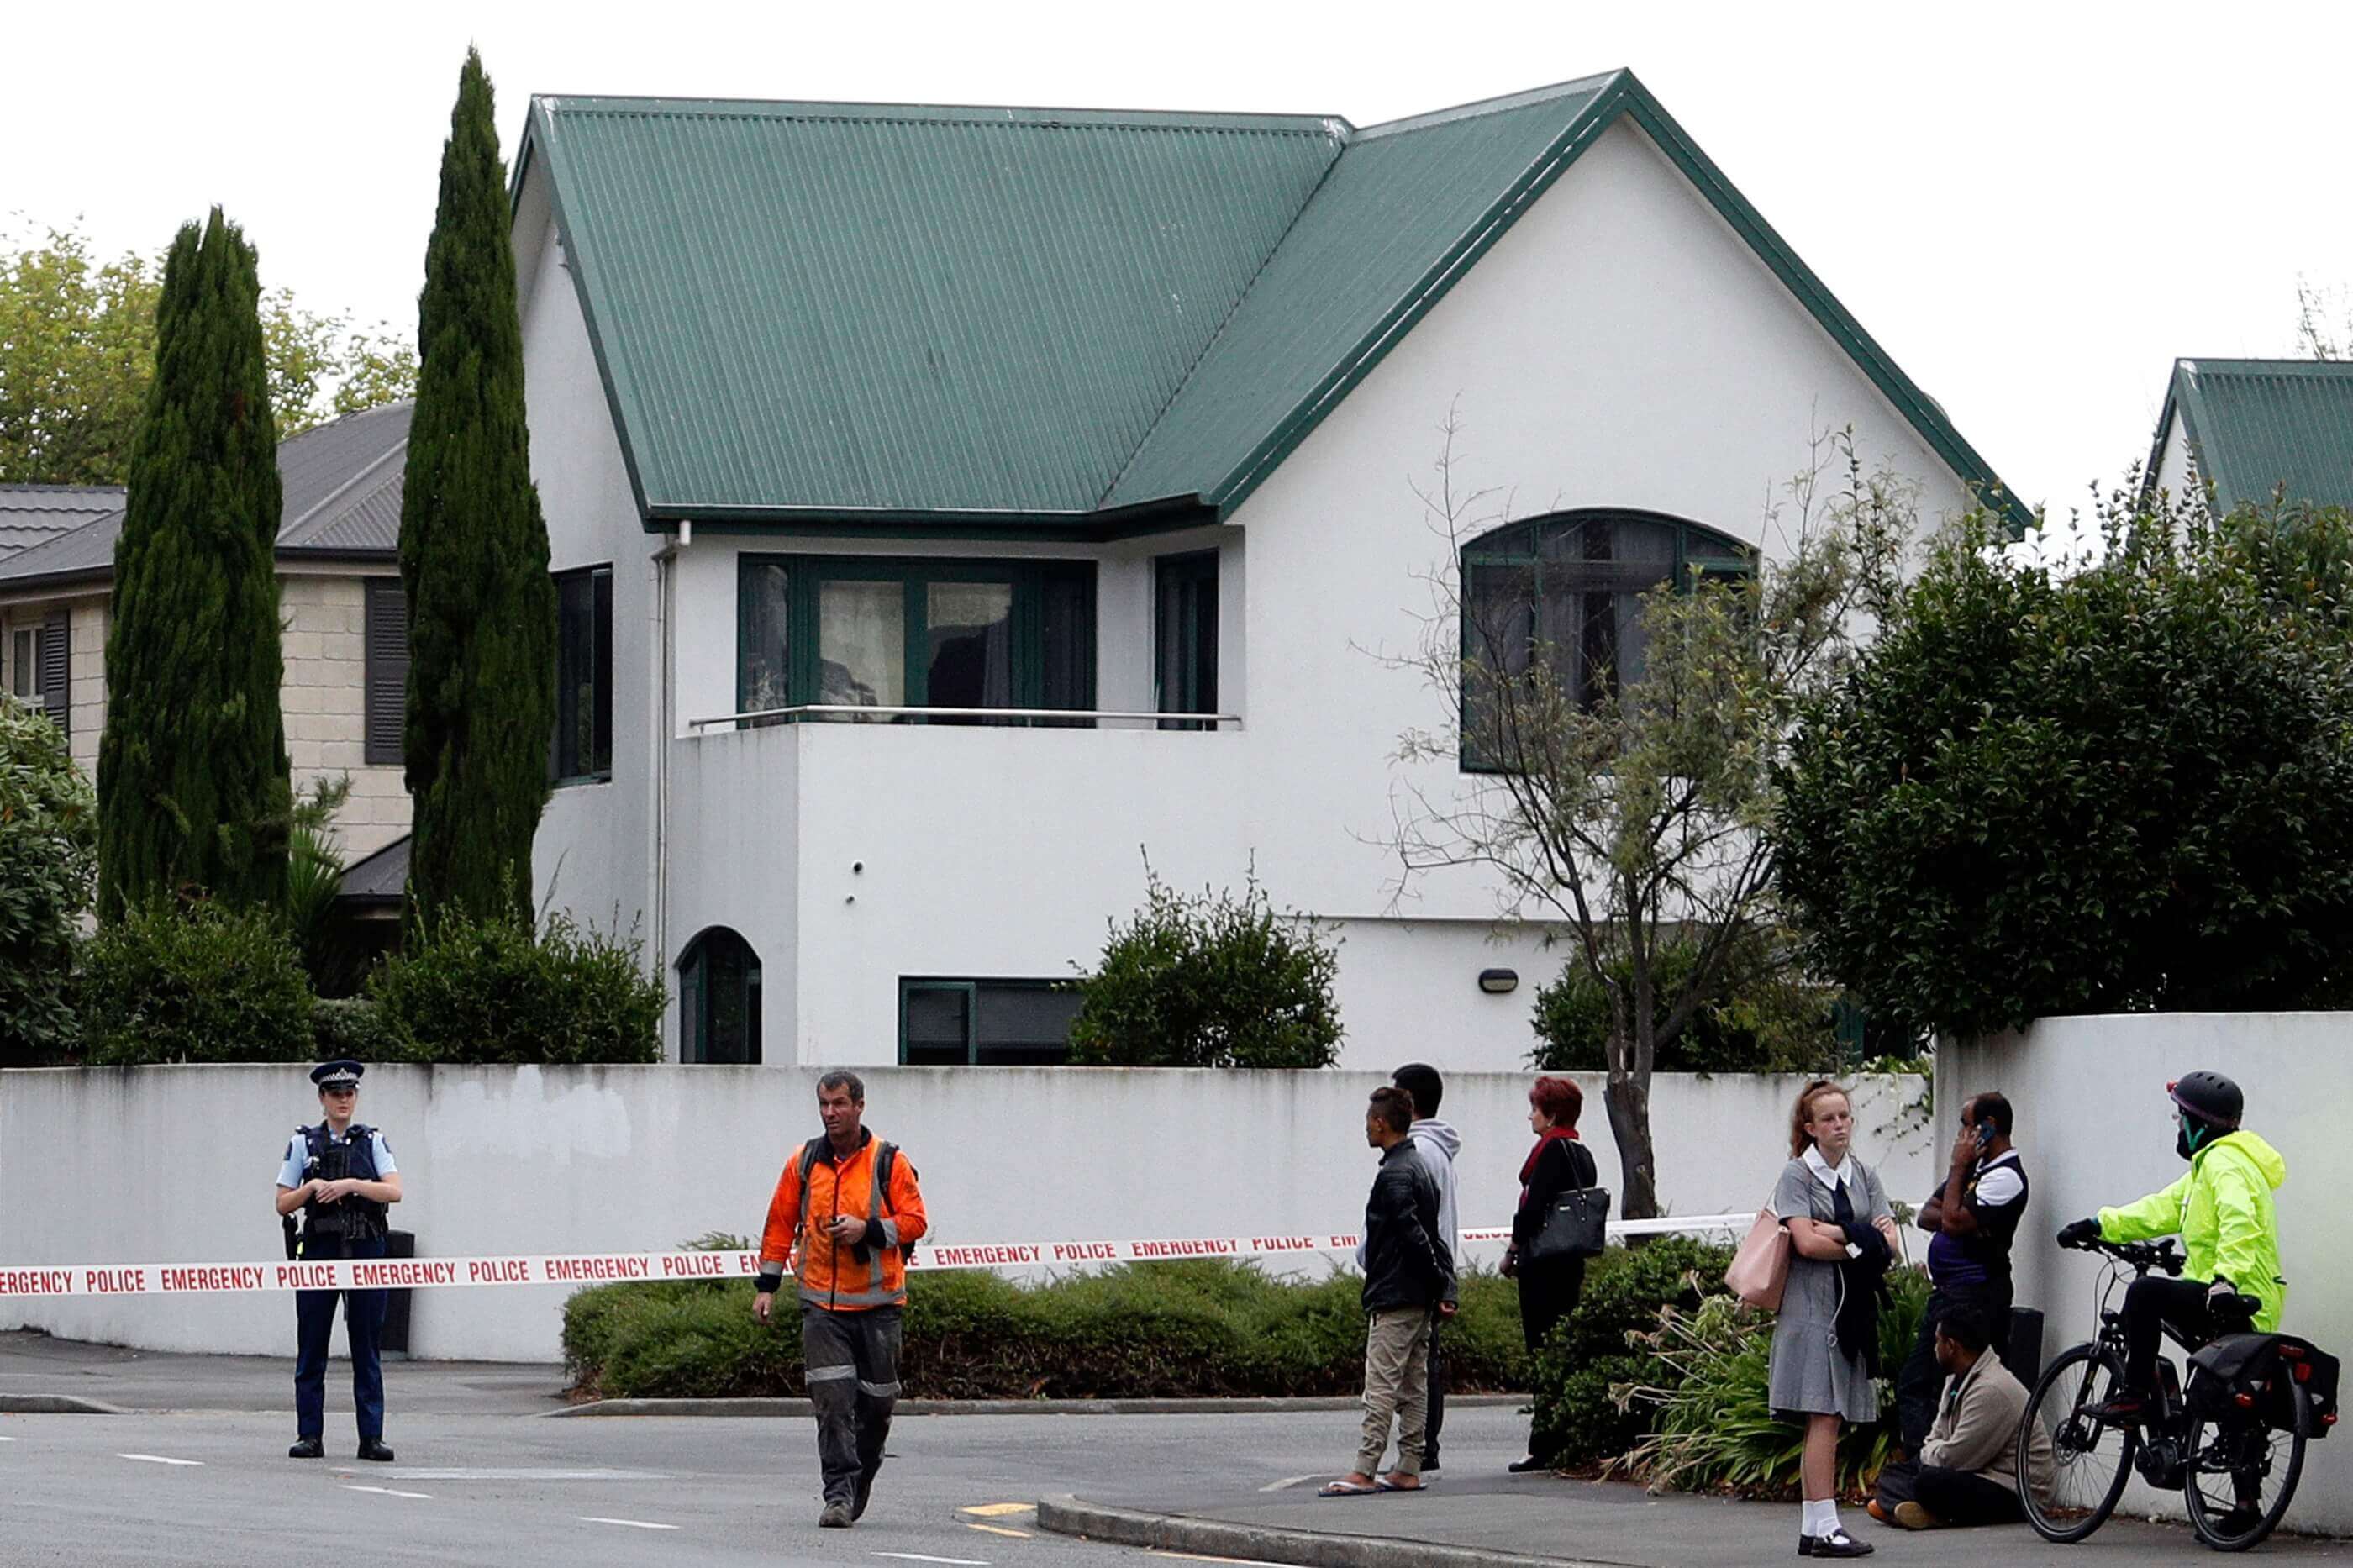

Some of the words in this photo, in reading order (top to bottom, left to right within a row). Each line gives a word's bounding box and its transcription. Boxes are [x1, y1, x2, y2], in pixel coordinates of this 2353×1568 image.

[87, 1270, 145, 1292] POLICE
[161, 1267, 263, 1291] EMERGENCY
[277, 1265, 336, 1288] POLICE
[352, 1263, 455, 1286] EMERGENCY
[469, 1260, 529, 1282] POLICE
[545, 1258, 649, 1281] EMERGENCY
[662, 1255, 724, 1276] POLICE
[934, 1246, 1040, 1265] EMERGENCY
[1054, 1243, 1116, 1260] POLICE
[1131, 1239, 1237, 1257] EMERGENCY
